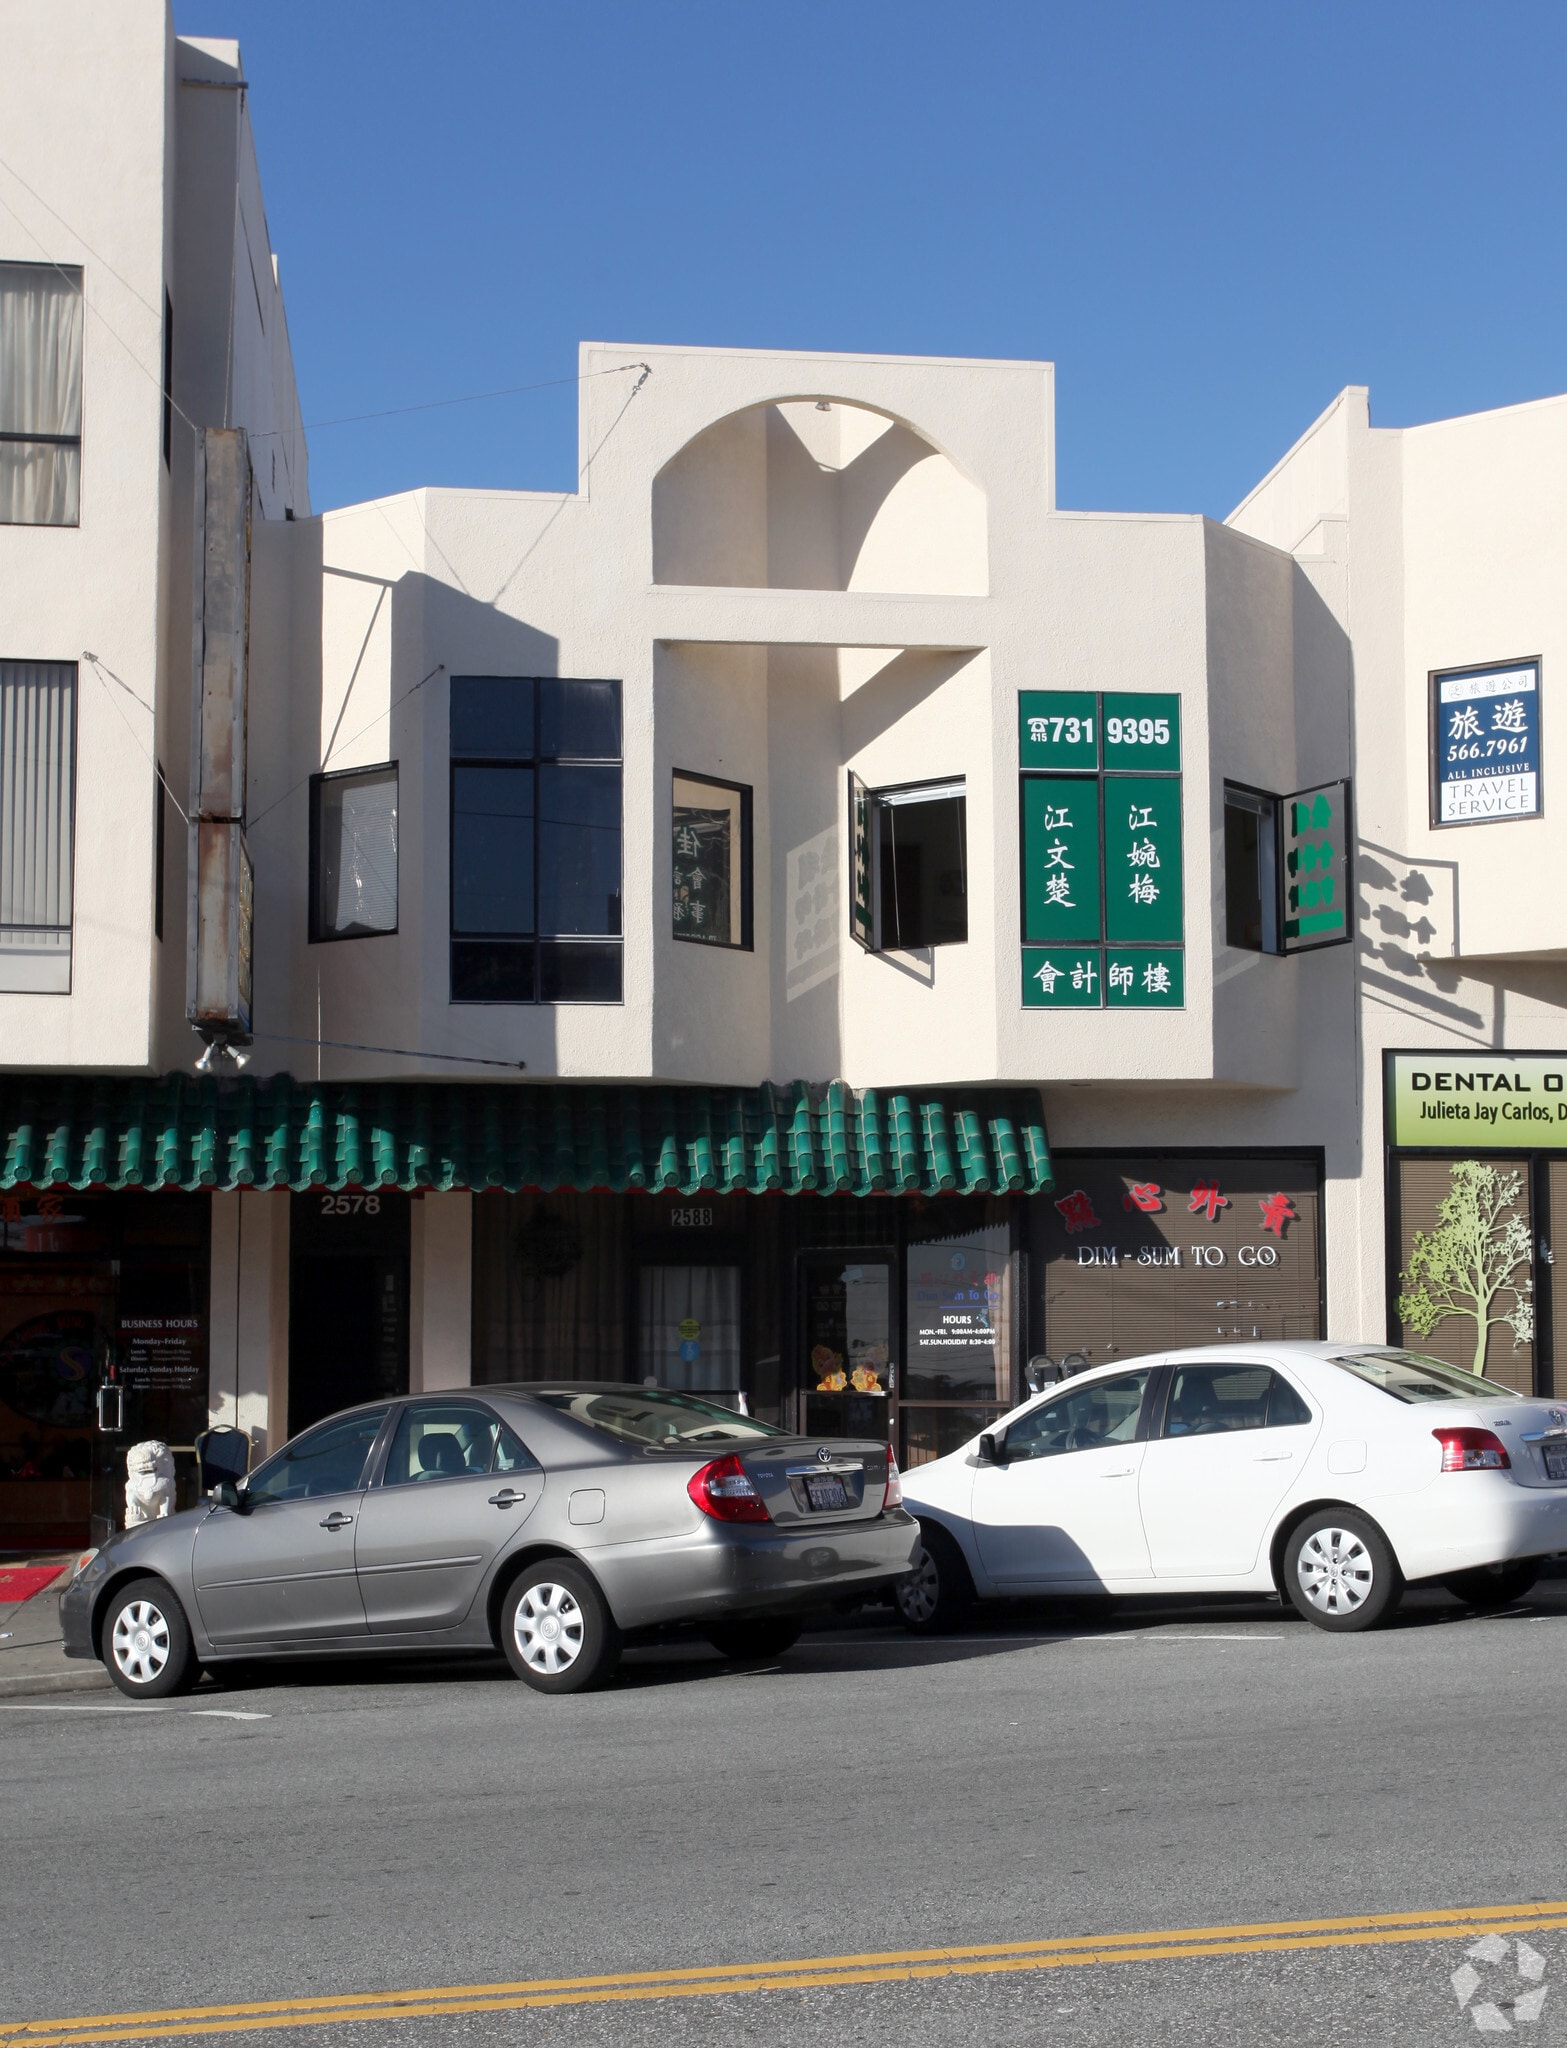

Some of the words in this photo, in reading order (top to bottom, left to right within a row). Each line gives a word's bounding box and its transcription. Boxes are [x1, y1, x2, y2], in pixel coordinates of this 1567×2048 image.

[1448, 699, 1528, 740] 旅遊
[1030, 732, 1047, 742] 415
[1050, 717, 1093, 743] 731
[1107, 718, 1170, 745] 9395
[1447, 736, 1528, 762] 566.7961
[1448, 770, 1467, 781] ALL
[1471, 762, 1530, 778] INCLUSIVE
[1449, 777, 1528, 799] TRAVEL
[1448, 794, 1529, 816] SERVICE
[1044, 804, 1077, 908] 江文楚
[1127, 804, 1161, 905] 江婉梅
[1033, 961, 1172, 996] 會計師樓
[1411, 1072, 1532, 1092] DENTAL
[1420, 1101, 1470, 1120] Julieta
[1474, 1102, 1498, 1125] Jay
[1501, 1102, 1554, 1124] Carlos,
[321, 1195, 381, 1214] 2578
[672, 1208, 712, 1226] 2588
[1077, 1246, 1118, 1265] DIM
[1137, 1246, 1180, 1265] SUM
[1191, 1246, 1224, 1265] TO
[1238, 1245, 1277, 1266] GO
[969, 1288, 980, 1301] To
[121, 1319, 163, 1328] BUSINESS
[166, 1319, 198, 1328] HOURS
[943, 1315, 972, 1324] HOURS
[132, 1338, 186, 1346] Monday-Friday
